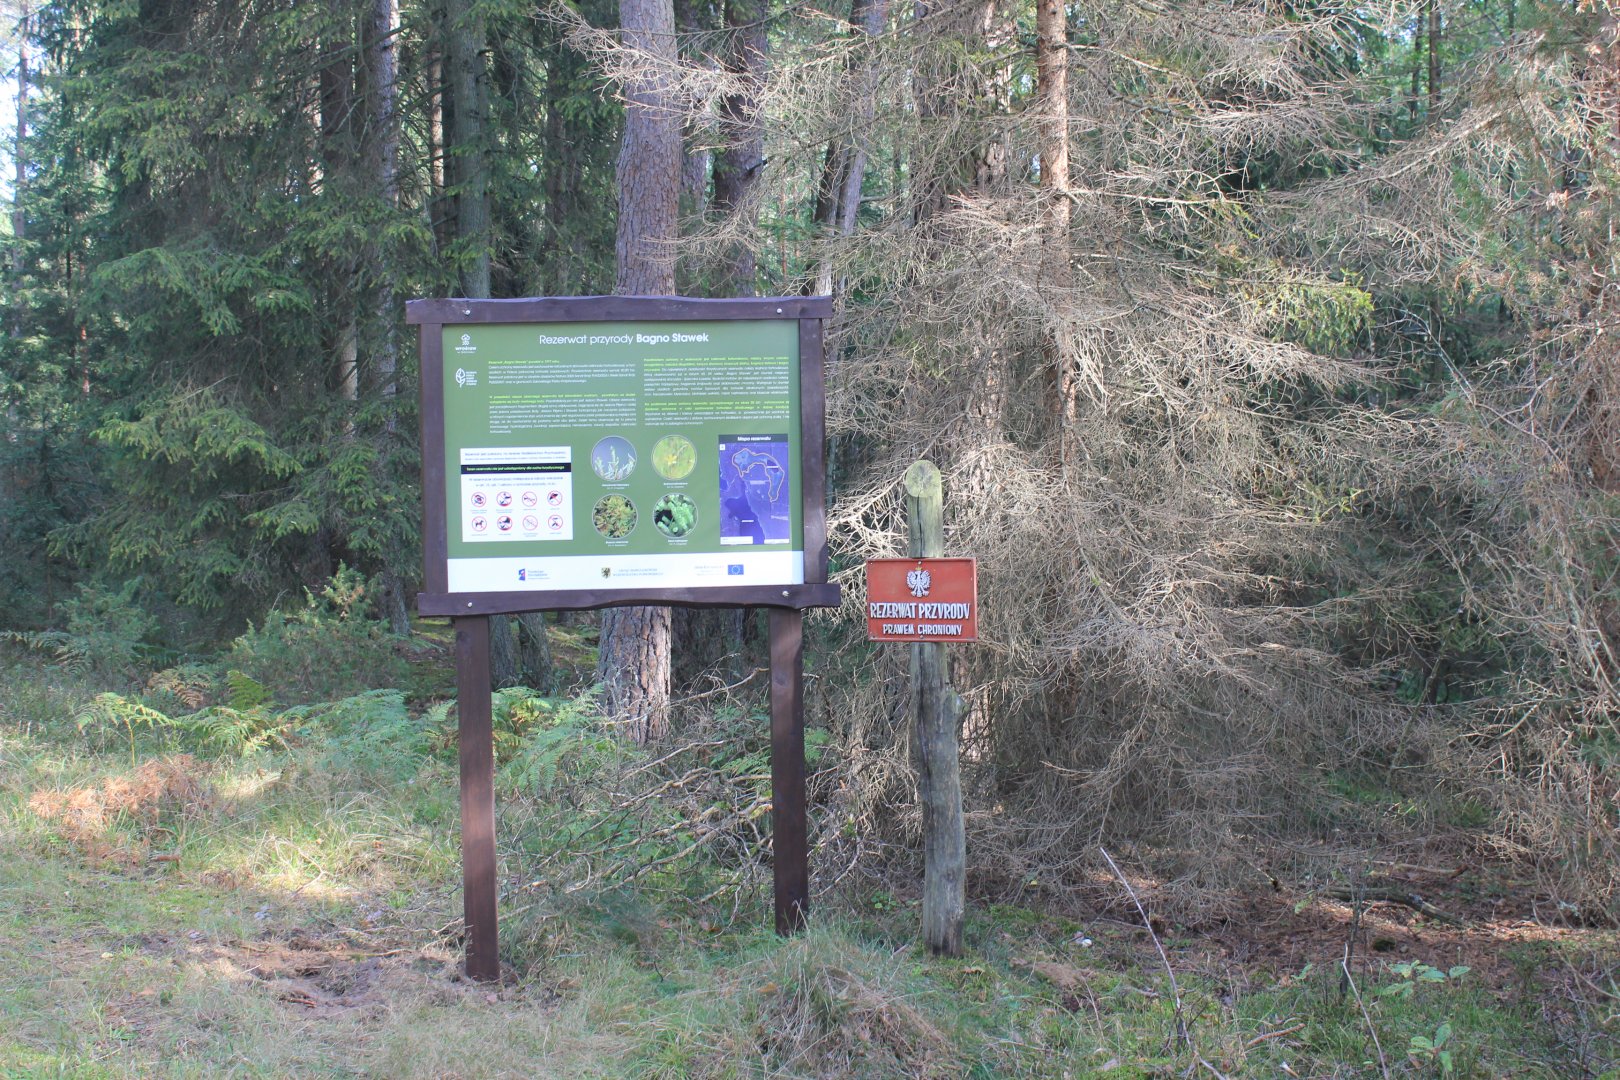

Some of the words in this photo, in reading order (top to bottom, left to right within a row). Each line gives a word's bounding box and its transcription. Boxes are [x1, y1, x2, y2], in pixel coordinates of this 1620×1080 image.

[539, 334, 587, 345] Rezerwat
[589, 334, 634, 346] przyrody
[636, 333, 670, 344] Bagno
[672, 333, 709, 343] Stawek
[870, 602, 917, 619] REZERWAT
[918, 603, 970, 620] PRZYRODY
[882, 624, 915, 635] PRAWEM
[917, 624, 963, 636] CHRONIONY
